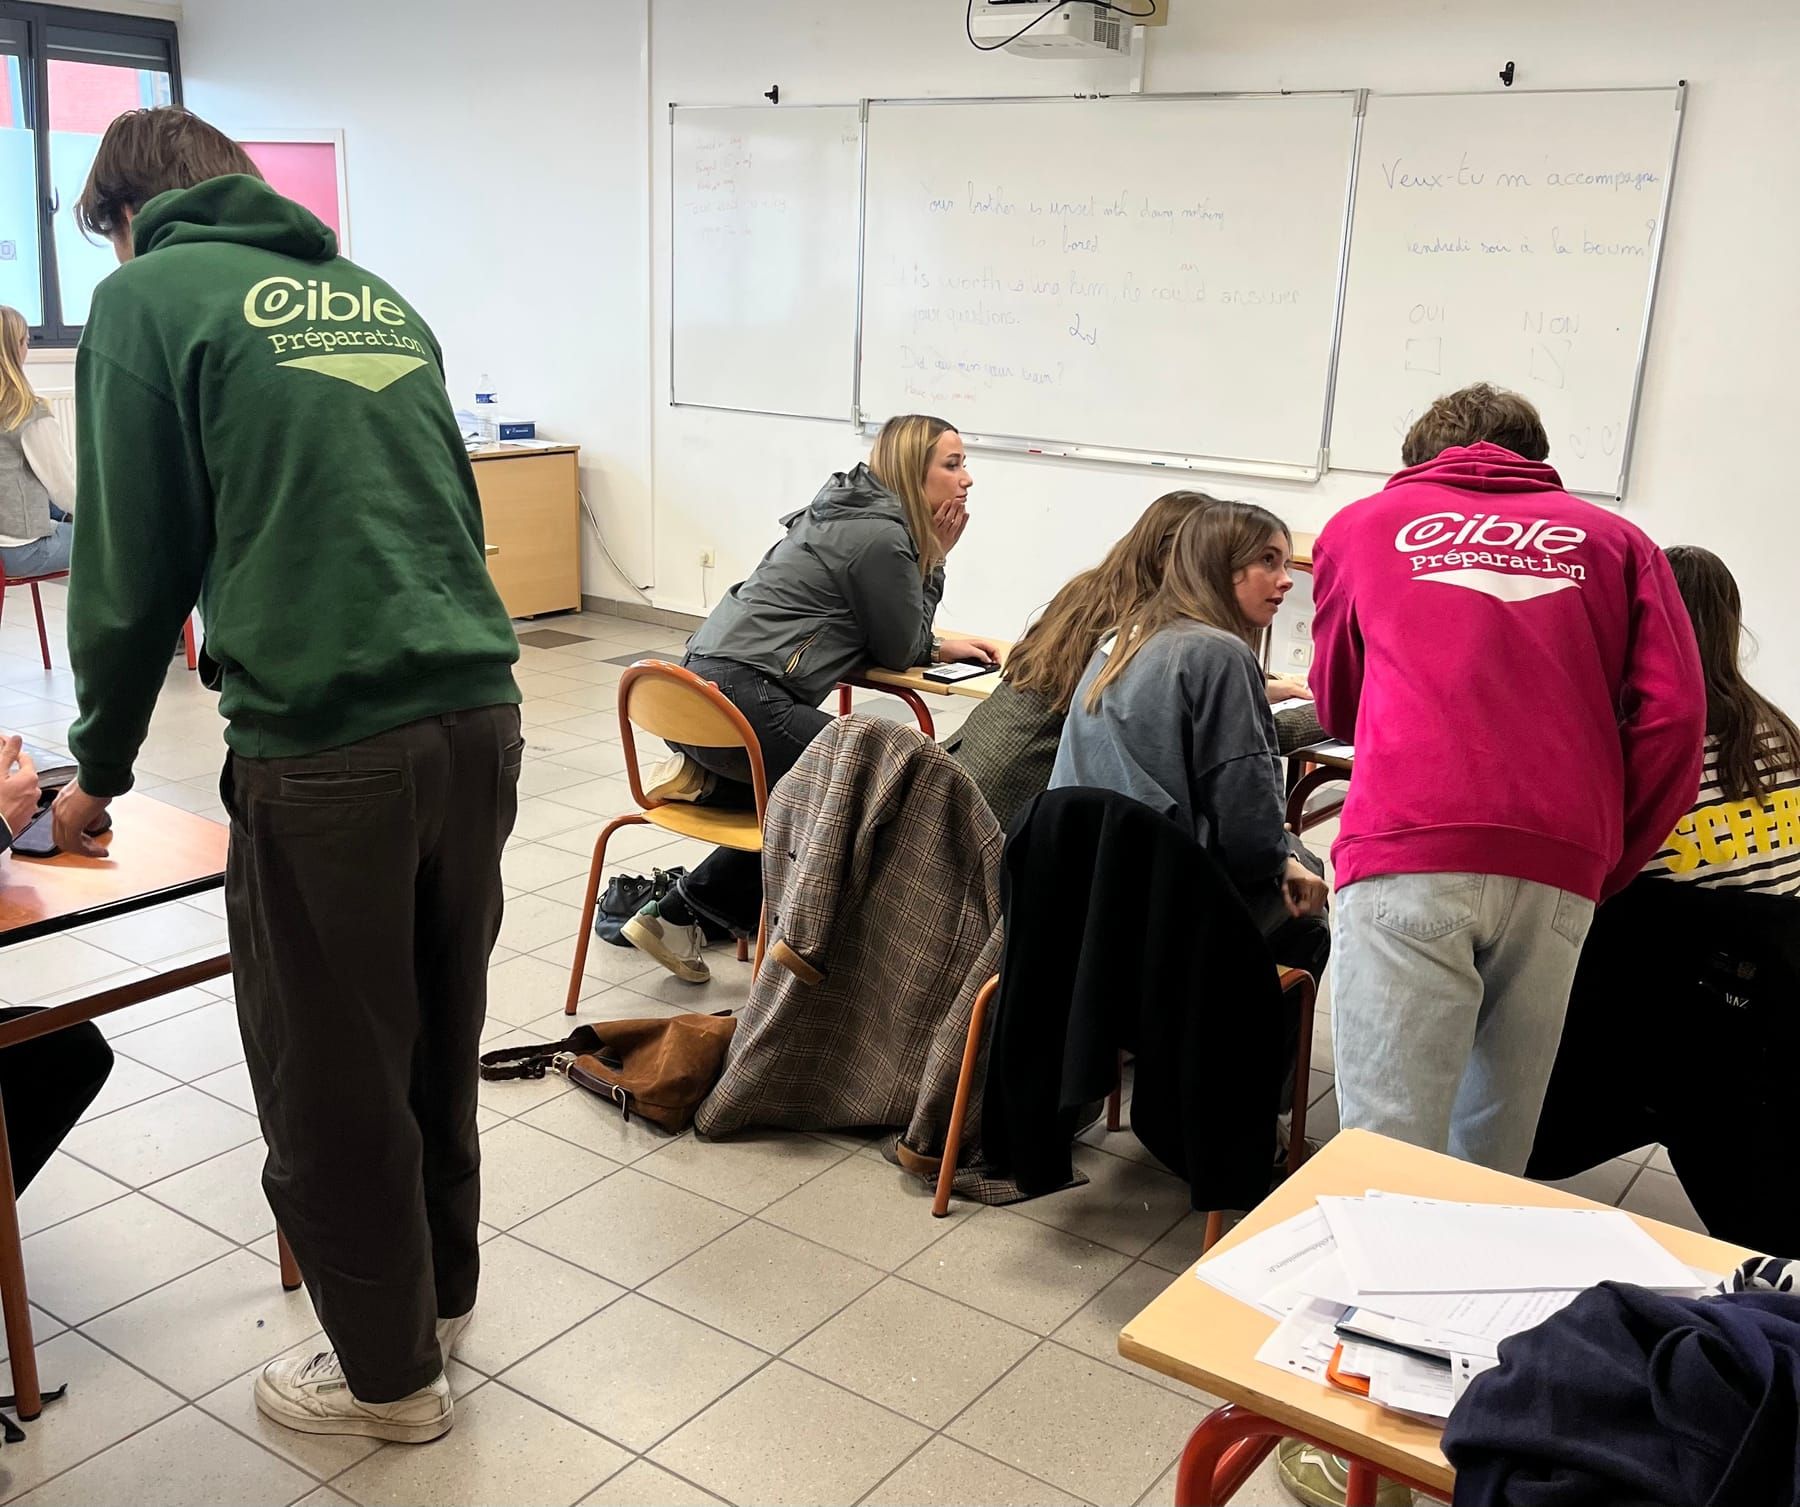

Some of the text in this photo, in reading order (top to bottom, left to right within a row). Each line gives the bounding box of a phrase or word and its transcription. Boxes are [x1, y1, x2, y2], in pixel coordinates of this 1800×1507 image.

[1381, 152, 1484, 190] Veux-tu
[967, 181, 1016, 215] brother
[1062, 224, 1099, 253] bored
[1552, 226, 1572, 255] la
[243, 276, 406, 328] Cible
[1408, 303, 1580, 334] OUI NON
[267, 327, 426, 354] Préparation
[1394, 512, 1587, 554] Cible
[1409, 549, 1586, 580] Préparation
